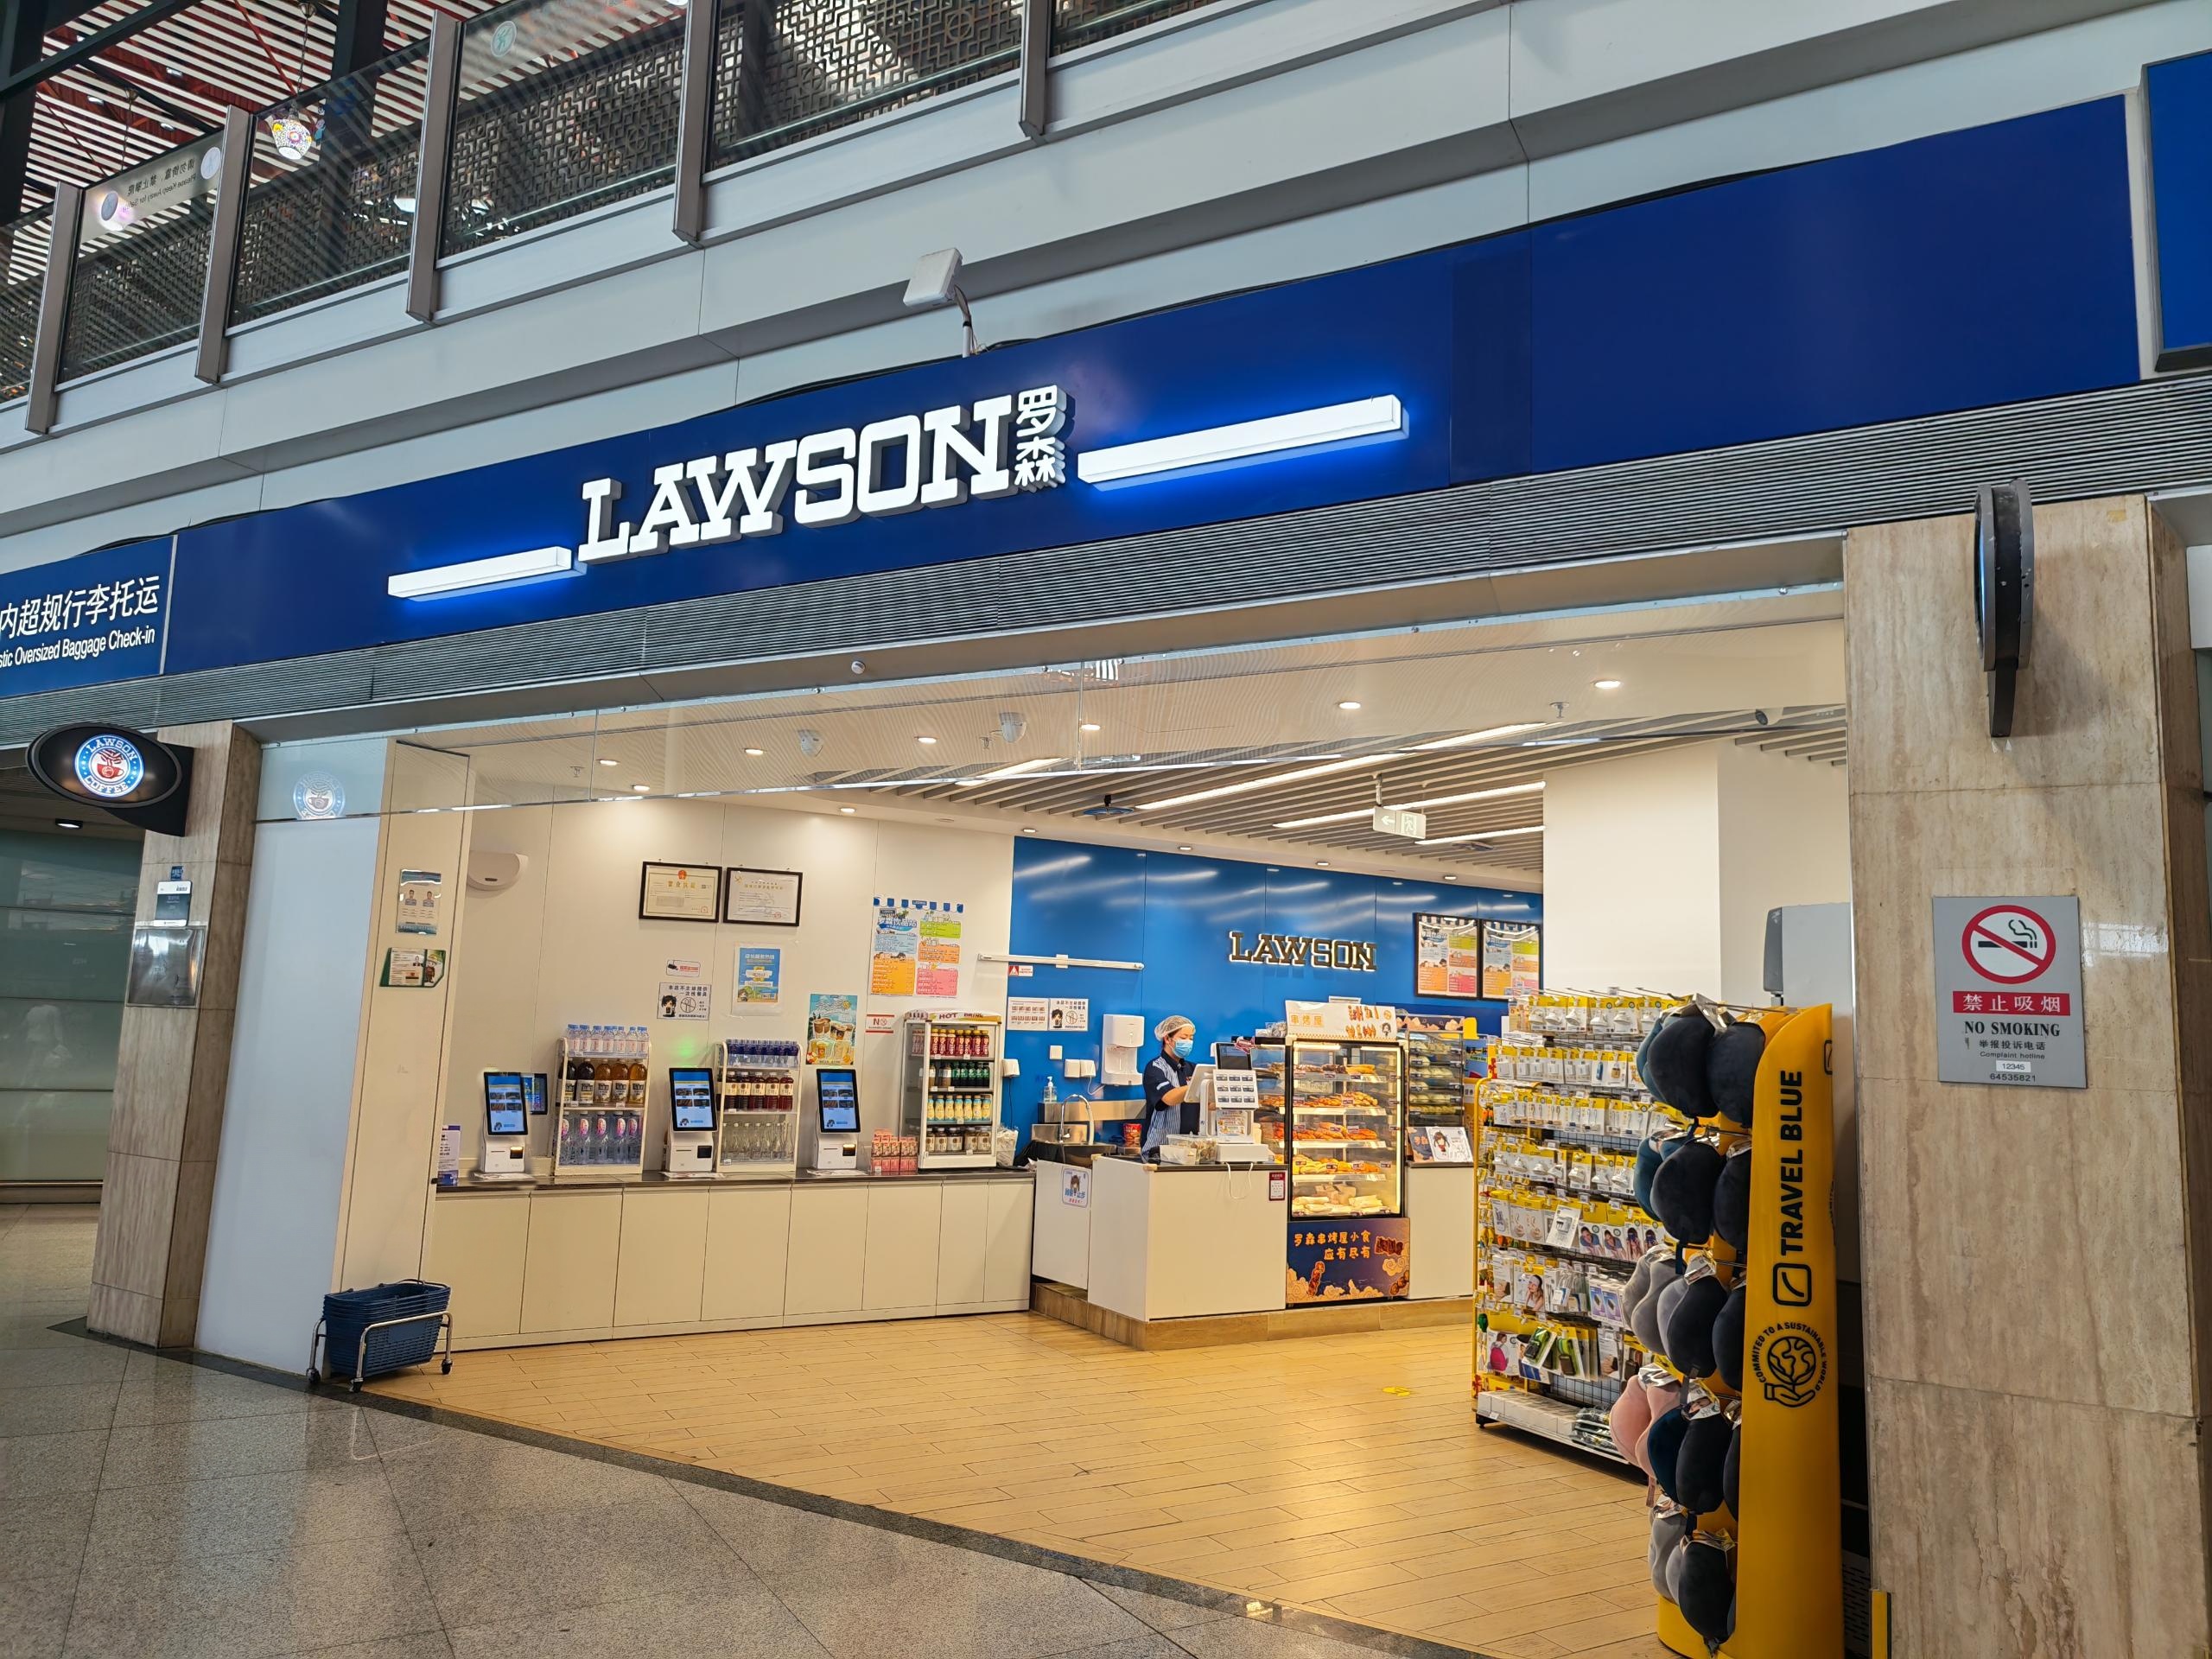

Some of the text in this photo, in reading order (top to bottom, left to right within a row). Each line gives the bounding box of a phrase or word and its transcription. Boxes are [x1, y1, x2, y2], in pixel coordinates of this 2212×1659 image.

[1014, 385, 1063, 487] 罗森
[578, 394, 1016, 563] LAWSON
[0, 575, 160, 639] 内超规行李托运
[15, 640, 60, 665] Oversized
[62, 639, 106, 660] Baggage
[109, 625, 156, 650] Check-in
[86, 738, 137, 760] LAWSON
[85, 775, 128, 793] COFFEE
[1229, 931, 1378, 972] LAWSON
[1962, 994, 2061, 1013] 禁止吸烟
[1964, 1020, 2060, 1037] NO SMOKING
[1979, 1039, 2046, 1051] 举报投诉电话
[1980, 1051, 2017, 1059] Complaint
[1990, 1073, 2036, 1082] 64535821
[1781, 1071, 1803, 1256] TRAVEL BLUE
[1294, 1230, 1371, 1247] 罗森串烤屋小食
[1324, 1245, 1371, 1261] 应有尽有
[1763, 1326, 1775, 1336] TO
[1784, 1322, 1827, 1357] SUSTAINABLE
[1815, 1360, 1827, 1391] WORLD
